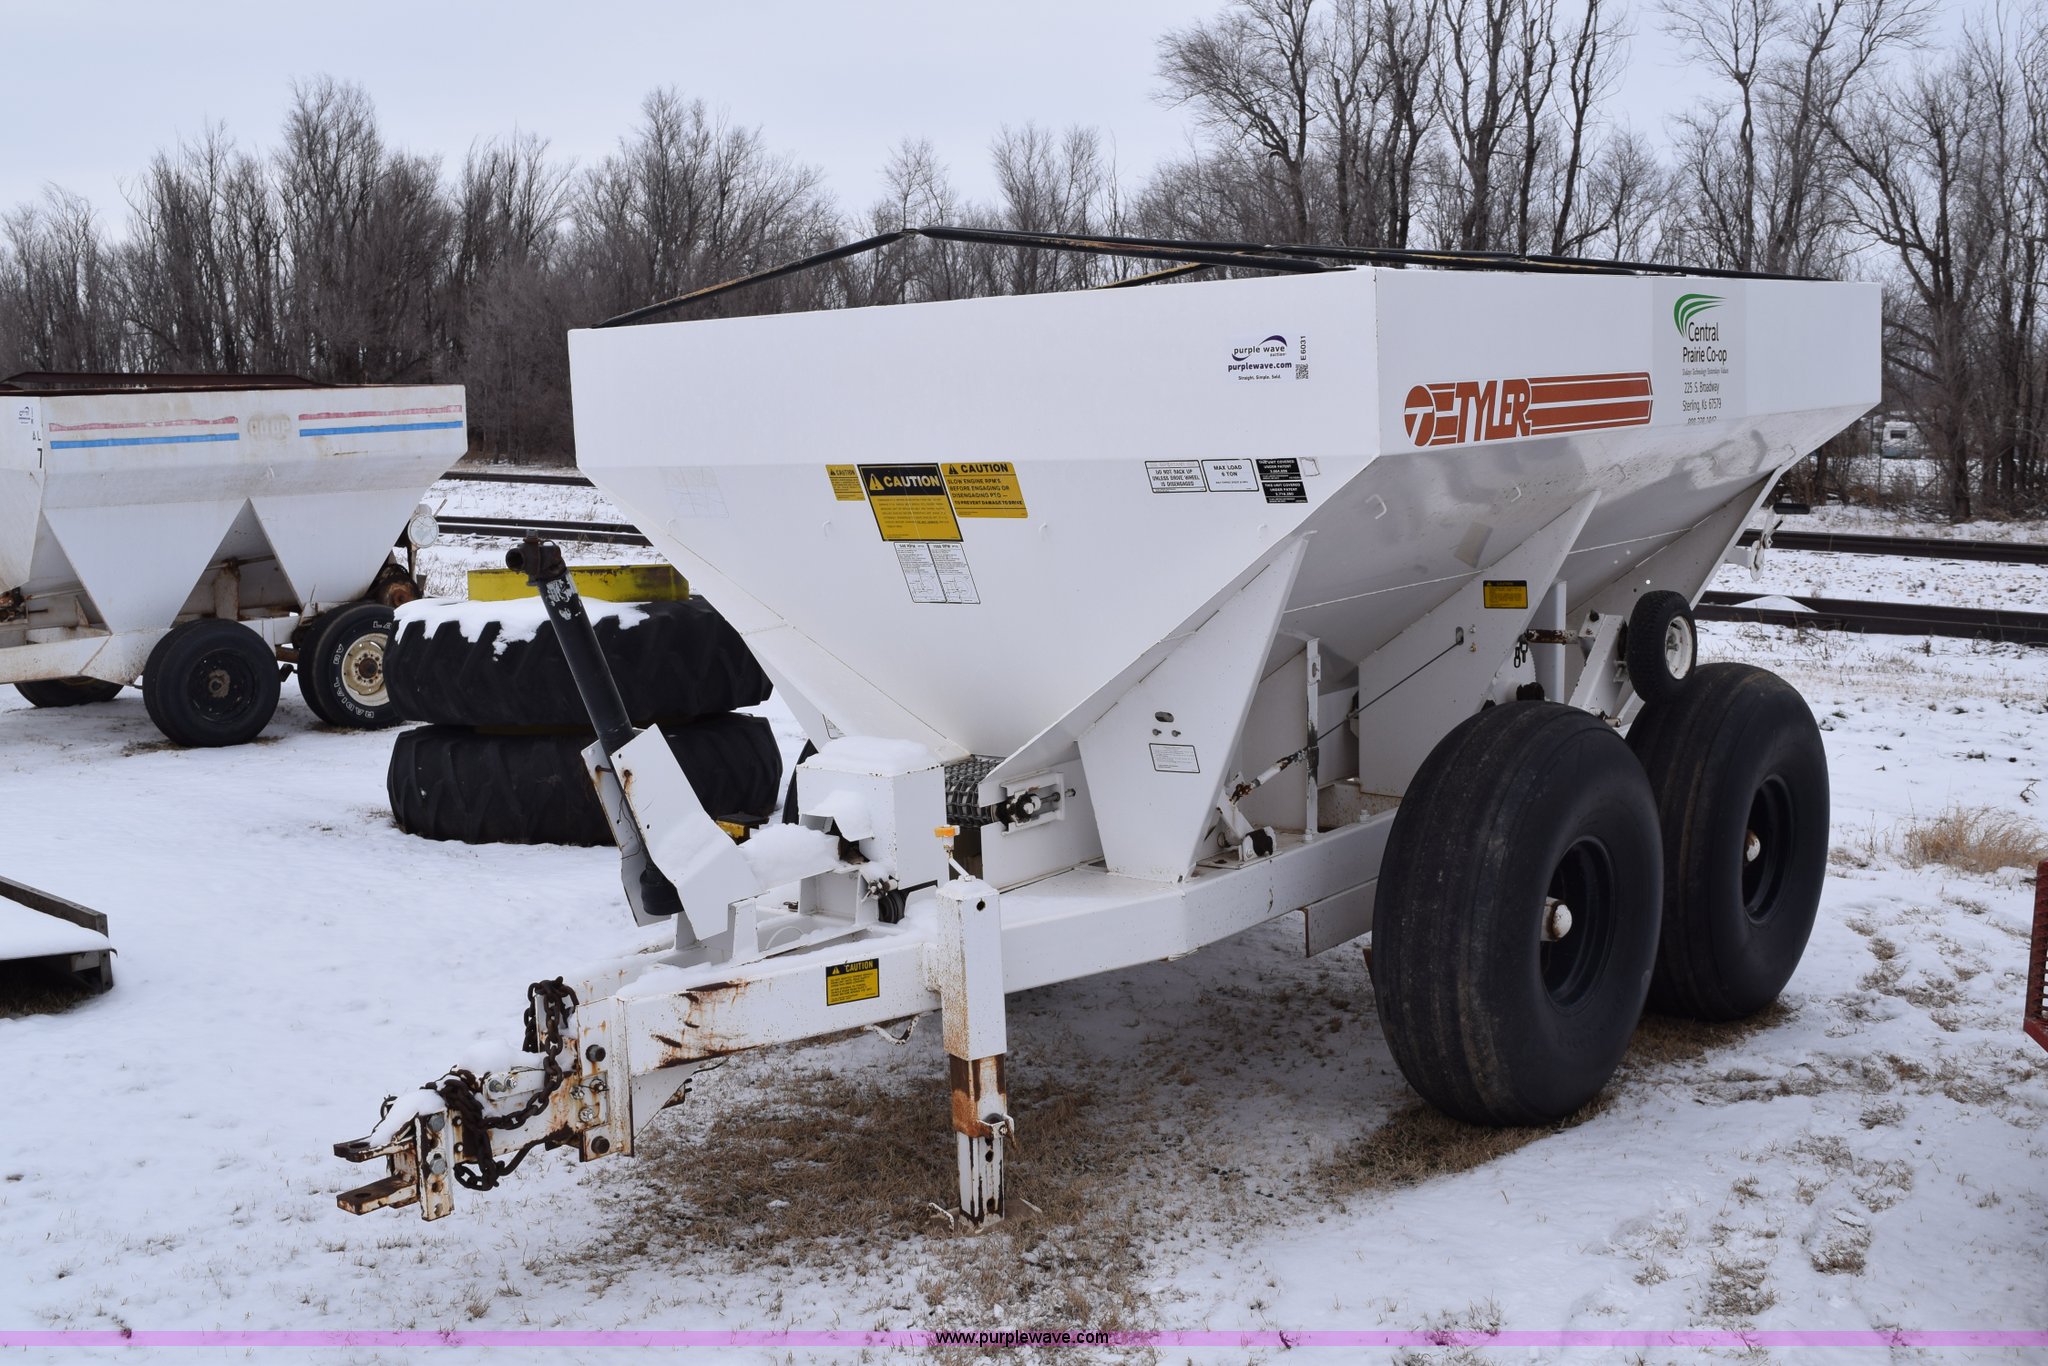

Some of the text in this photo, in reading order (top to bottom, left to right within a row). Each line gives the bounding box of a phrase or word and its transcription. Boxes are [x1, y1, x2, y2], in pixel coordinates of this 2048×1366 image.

[1688, 321, 1719, 341] Central
[1233, 345, 1260, 355] purple
[1682, 346, 1728, 365] Prairie Co-op
[1228, 362, 1292, 372] purplewave.com
[1684, 381, 1693, 394] 225
[1699, 381, 1720, 394] Broadway
[1455, 378, 1531, 443] TYLER
[960, 464, 1008, 473] CAUTION
[883, 475, 940, 488] CAUTION
[333, 677, 374, 718] RADIAL
[845, 960, 874, 973] CAUTION
